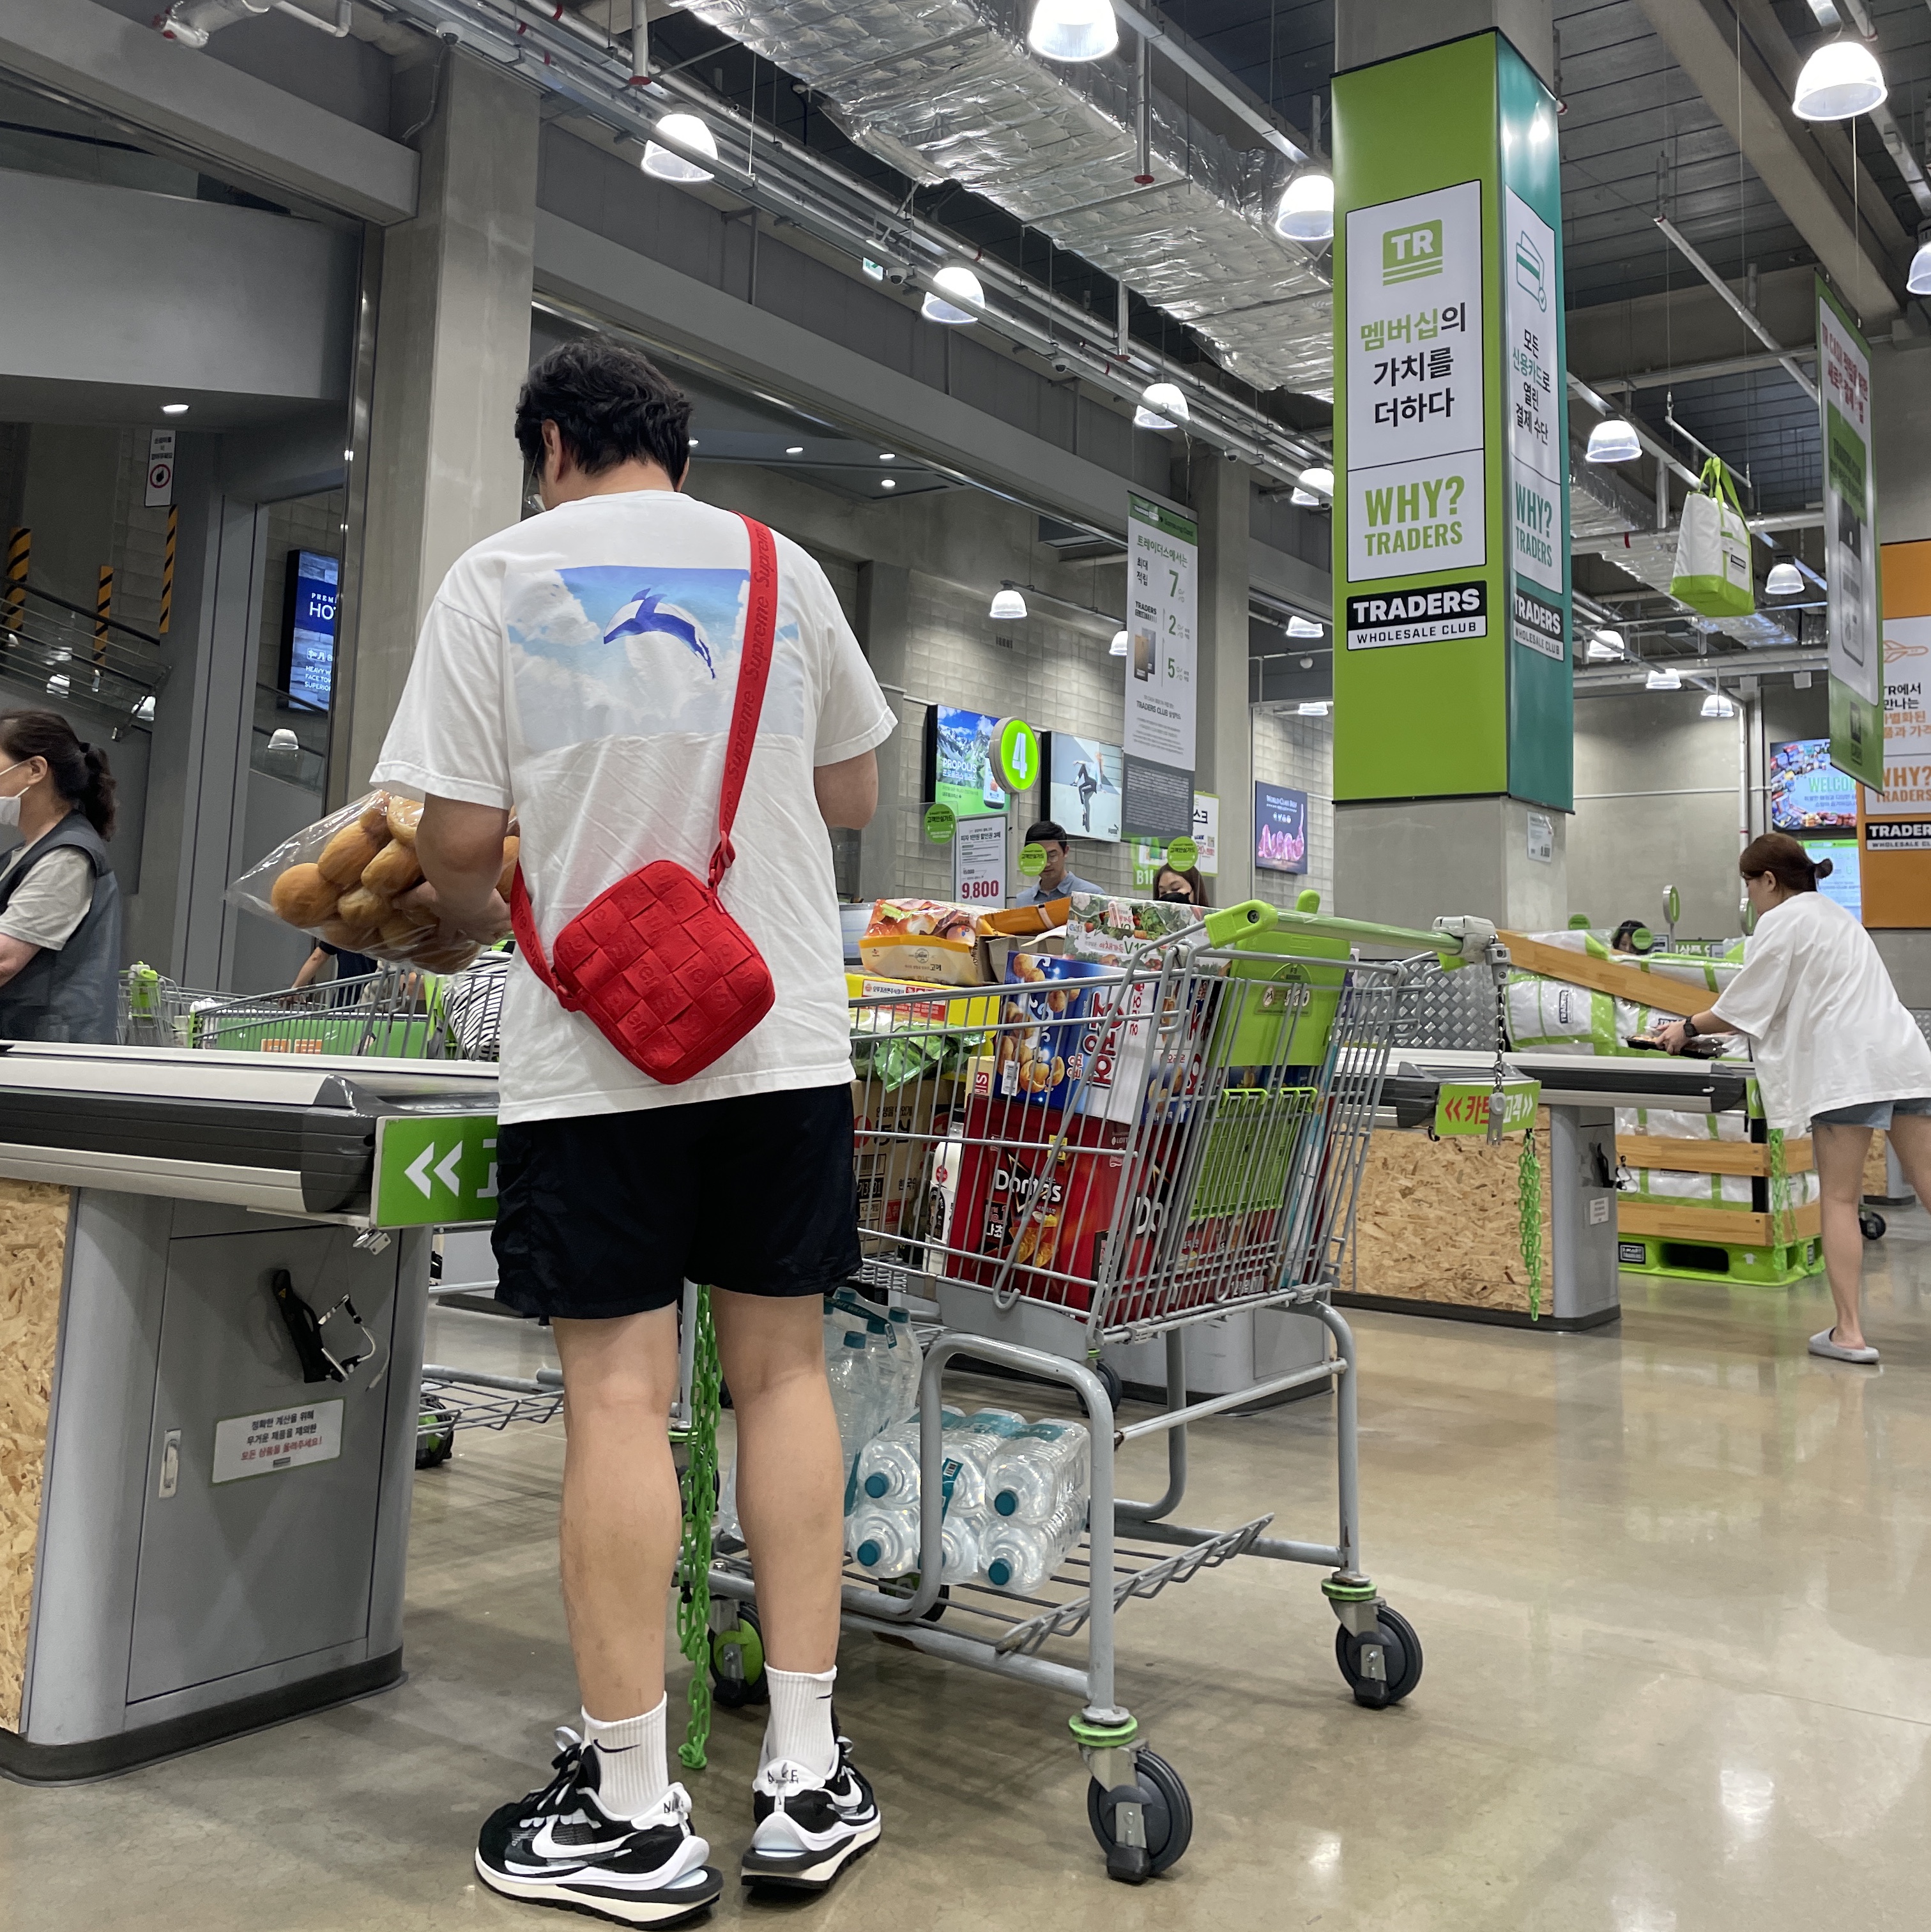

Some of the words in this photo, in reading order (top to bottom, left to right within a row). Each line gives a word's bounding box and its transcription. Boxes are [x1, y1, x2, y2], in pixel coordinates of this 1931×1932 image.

[1391, 229, 1433, 260] TR
[1361, 302, 1465, 351] 멤버십의
[1523, 328, 1539, 360] 모든
[1373, 347, 1454, 387] 가치를
[1513, 346, 1551, 393] 신용카드로
[1375, 388, 1454, 427] 더하다
[1523, 381, 1539, 413] 열린
[1516, 403, 1532, 434] 결제
[1534, 416, 1548, 445] 수단
[1365, 475, 1465, 527] WHY?
[1515, 482, 1553, 538] WHY?
[753, 522, 775, 588] Supreme
[1137, 535, 1188, 568] 트레이더스에서는
[1364, 521, 1463, 556] TRADERS
[1515, 526, 1553, 568] TRADERS
[1136, 571, 1148, 586] 적립
[309, 601, 336, 620] HO
[1135, 601, 1157, 615] TRADERS
[1353, 588, 1480, 623] TRADERS
[1514, 593, 1561, 635] TRADERS
[744, 596, 768, 681] Supreme
[1357, 626, 1436, 644] WHOLESALE
[1442, 622, 1476, 635] CLUB
[1515, 628, 1545, 650] WHOLESALE
[1546, 644, 1560, 655] CLUB
[1884, 682, 1921, 696] R에서
[1136, 700, 1156, 712] TRADERS
[1157, 706, 1168, 716] CLUB
[728, 690, 755, 780] Supreme
[942, 757, 977, 773] PROPOLIS
[1012, 732, 1027, 779] 4
[962, 880, 999, 899] 9,800
[252, 1418, 274, 1431] 정확한
[275, 1413, 298, 1426] 계산을
[300, 1410, 314, 1421] 위해
[247, 1433, 269, 1445] 무거운
